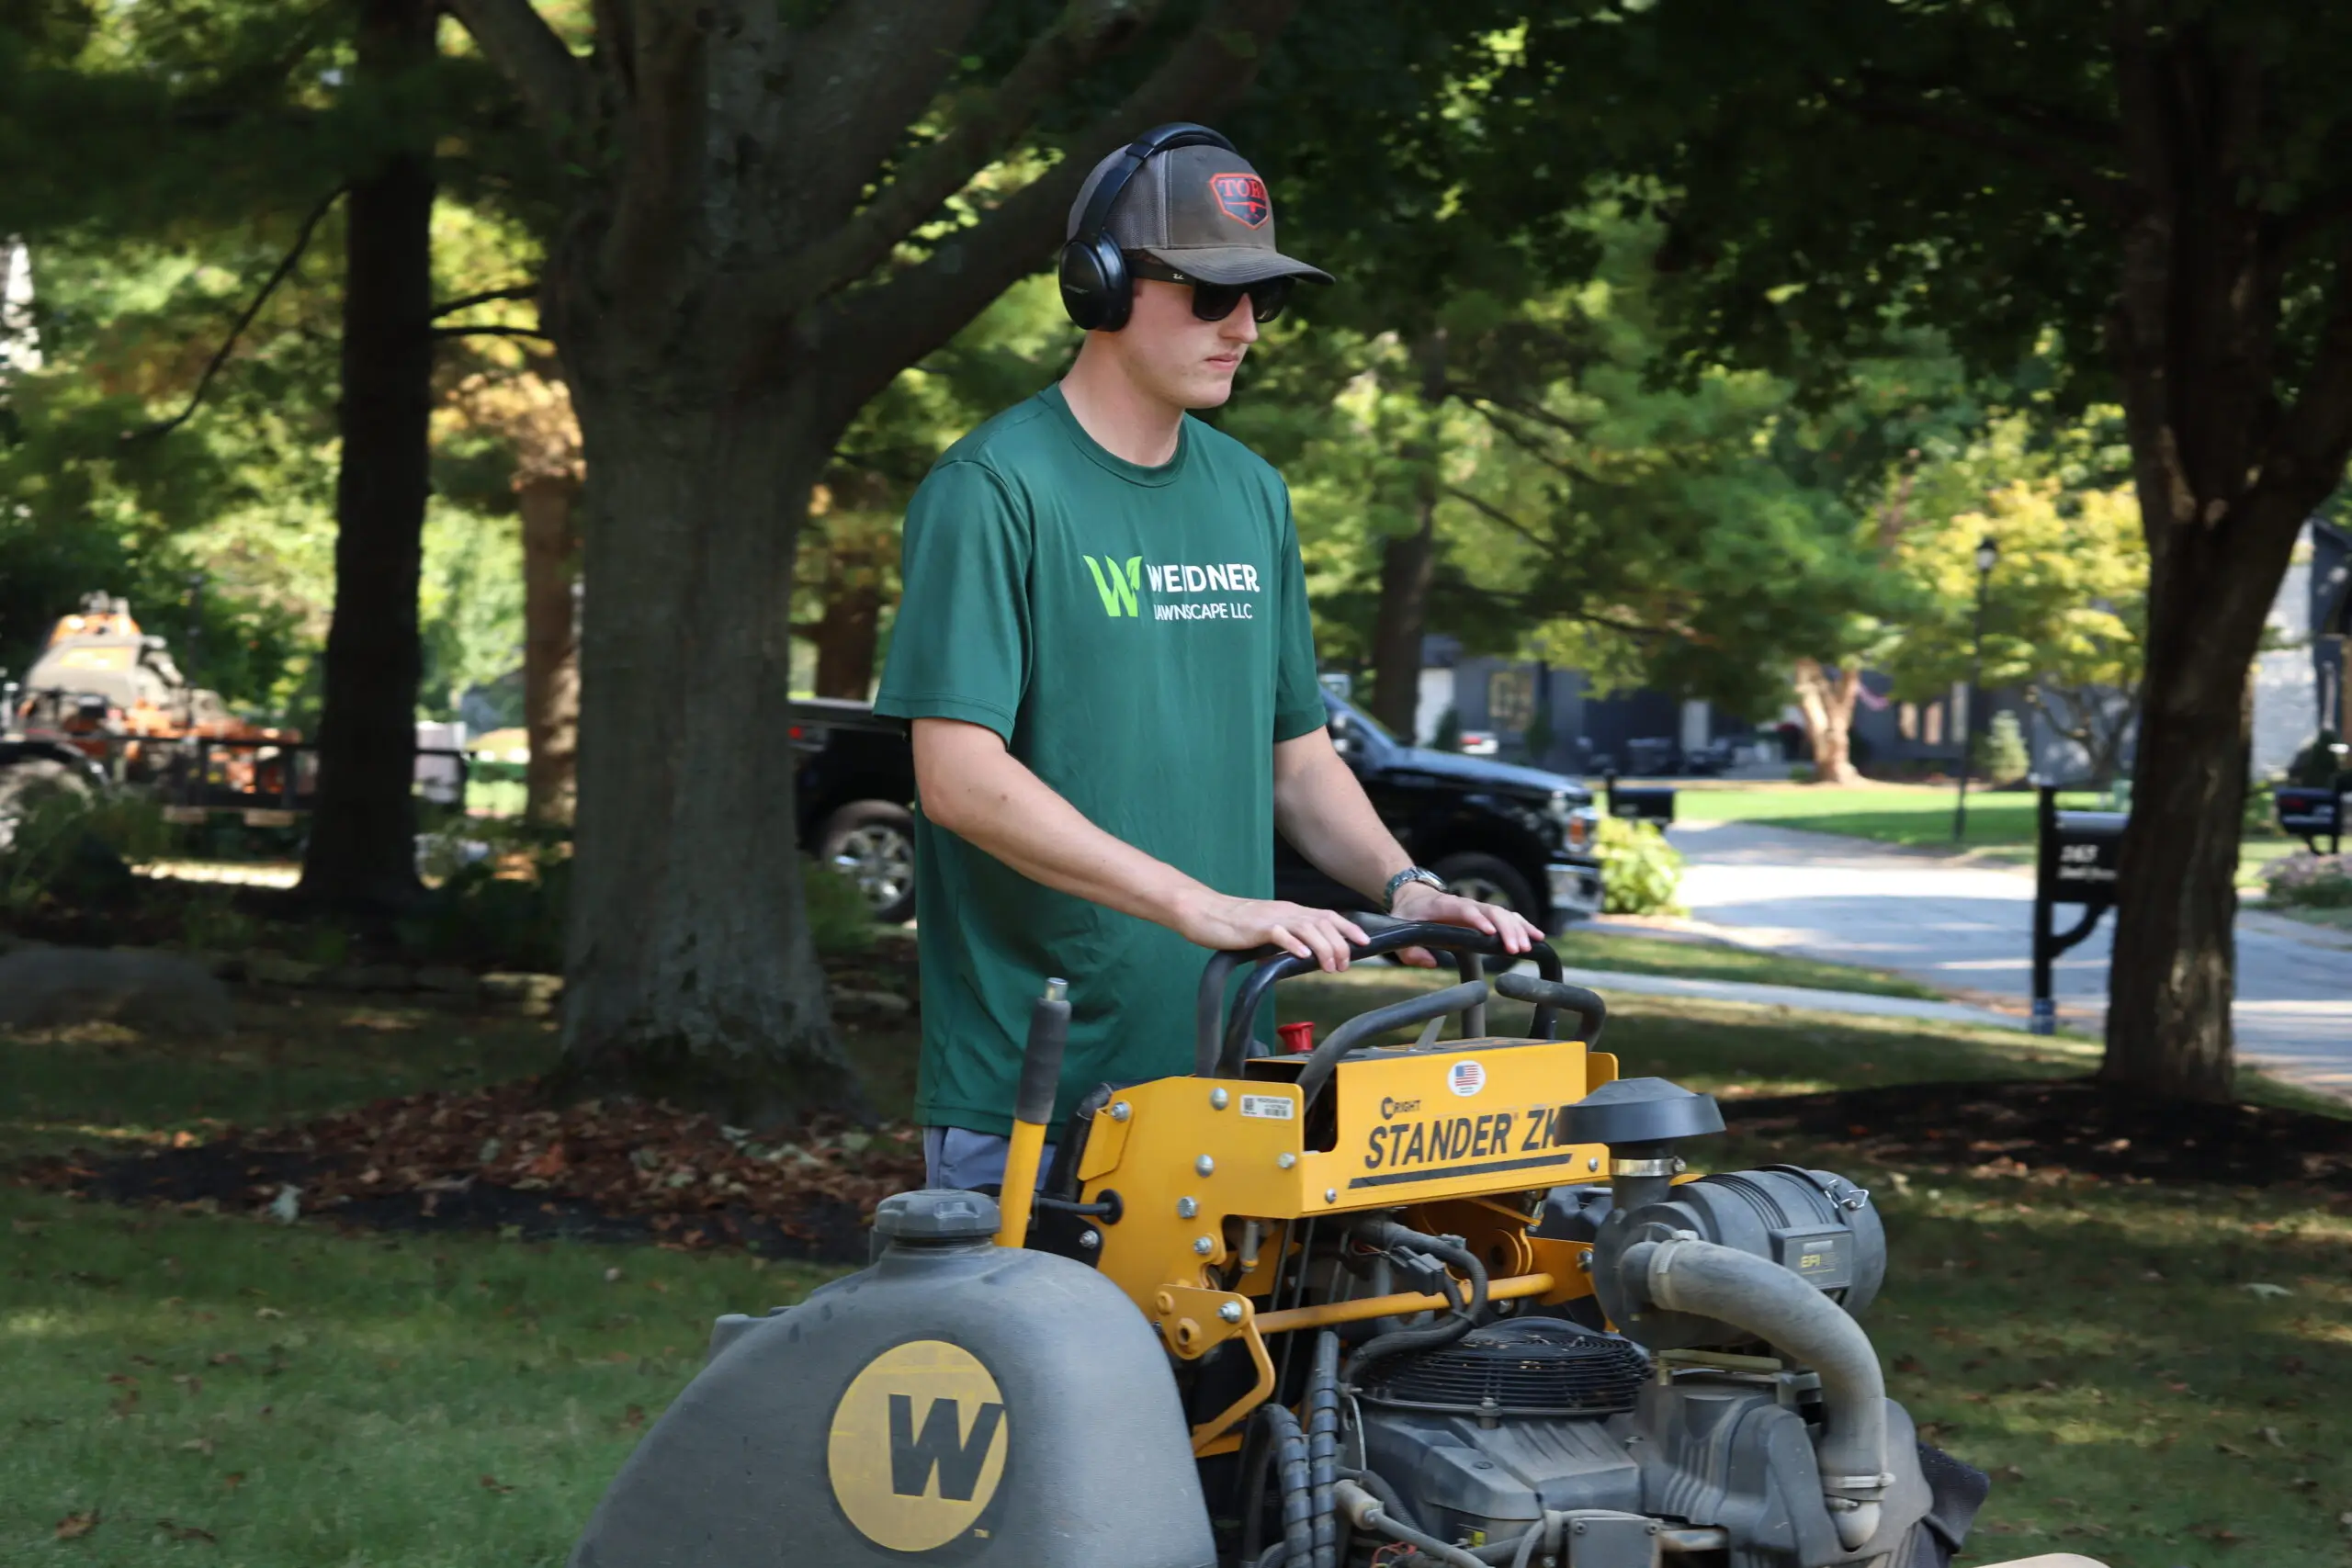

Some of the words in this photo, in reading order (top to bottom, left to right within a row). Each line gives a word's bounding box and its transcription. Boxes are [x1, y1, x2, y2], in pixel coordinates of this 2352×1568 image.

[1216, 179, 1266, 199] TOR
[1146, 563, 1261, 592] WEIDNER
[1153, 603, 1229, 621] LAWNSCAPE
[1229, 603, 1253, 620] LLC
[1364, 1112, 1512, 1169] STANDER
[888, 1393, 1006, 1502] W
